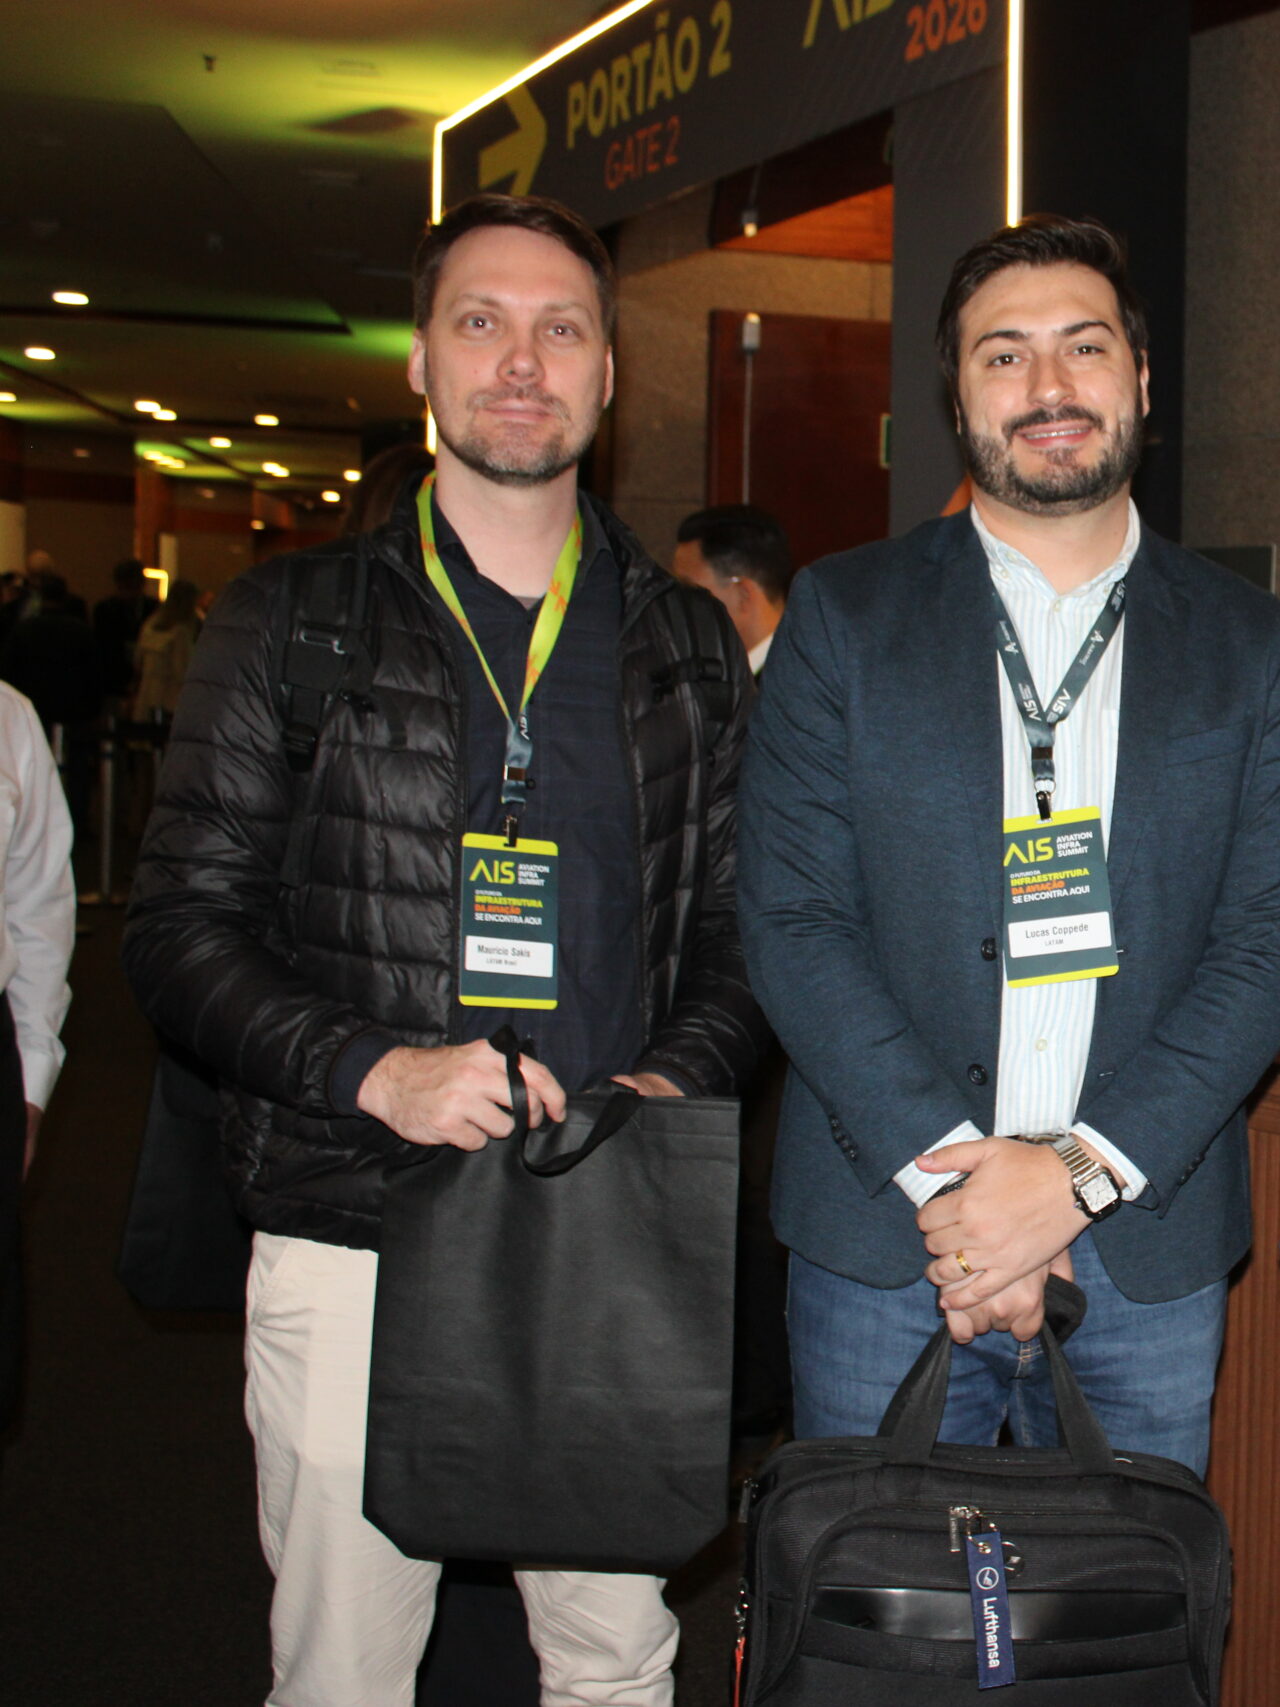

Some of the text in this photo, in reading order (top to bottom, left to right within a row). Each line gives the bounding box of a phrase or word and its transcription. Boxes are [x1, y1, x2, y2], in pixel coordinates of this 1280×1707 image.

[904, 0, 988, 62] 2026
[566, 11, 699, 149] PORTÃO
[708, 0, 733, 77] 2
[603, 116, 681, 191] GATE 2
[1056, 831, 1093, 843] AVIATION
[1057, 840, 1081, 850] INFRA
[1003, 837, 1054, 867] AIS
[1057, 846, 1089, 857] SUMMIT
[469, 858, 516, 885] AIS
[1010, 867, 1090, 887] INFRAESTRUTURA
[1011, 886, 1024, 895] DA
[1012, 885, 1090, 904] SE ENCONTRA AQUI
[1025, 923, 1089, 938] Lucas Coppede
[982, 1596, 1001, 1669] Lufthansa
